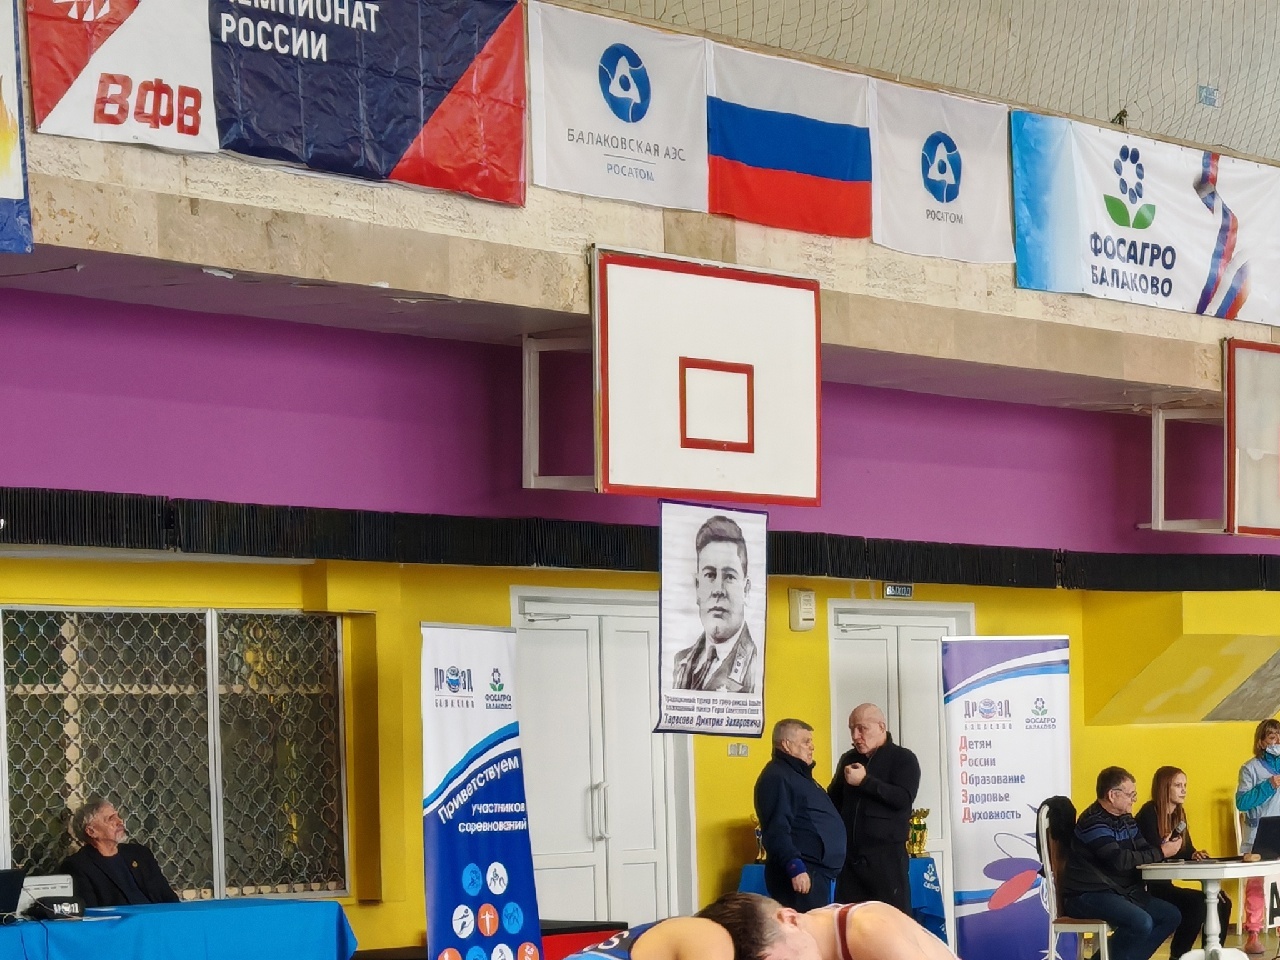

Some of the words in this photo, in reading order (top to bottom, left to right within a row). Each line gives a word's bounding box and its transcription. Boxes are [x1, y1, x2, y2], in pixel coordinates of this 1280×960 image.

[220, 12, 328, 62] РОССИИ
[93, 72, 202, 137] ВФВ
[567, 128, 660, 157] БАЛАКОВСКАЯ
[663, 146, 686, 162] АЭС
[606, 163, 655, 181] РОСАТОМ
[926, 208, 964, 224] РОСАТОМ
[1089, 231, 1177, 270] ФОСАГРО
[1091, 265, 1173, 298] БАЛАКОВО
[959, 735, 992, 751] Детям
[959, 753, 996, 768] России
[961, 771, 1025, 787] Образование
[437, 755, 520, 825] Приветствуем
[962, 788, 1010, 805] Здоровье
[471, 802, 526, 817] участников
[962, 806, 1021, 823] Духовность
[458, 817, 527, 835] соревнований
